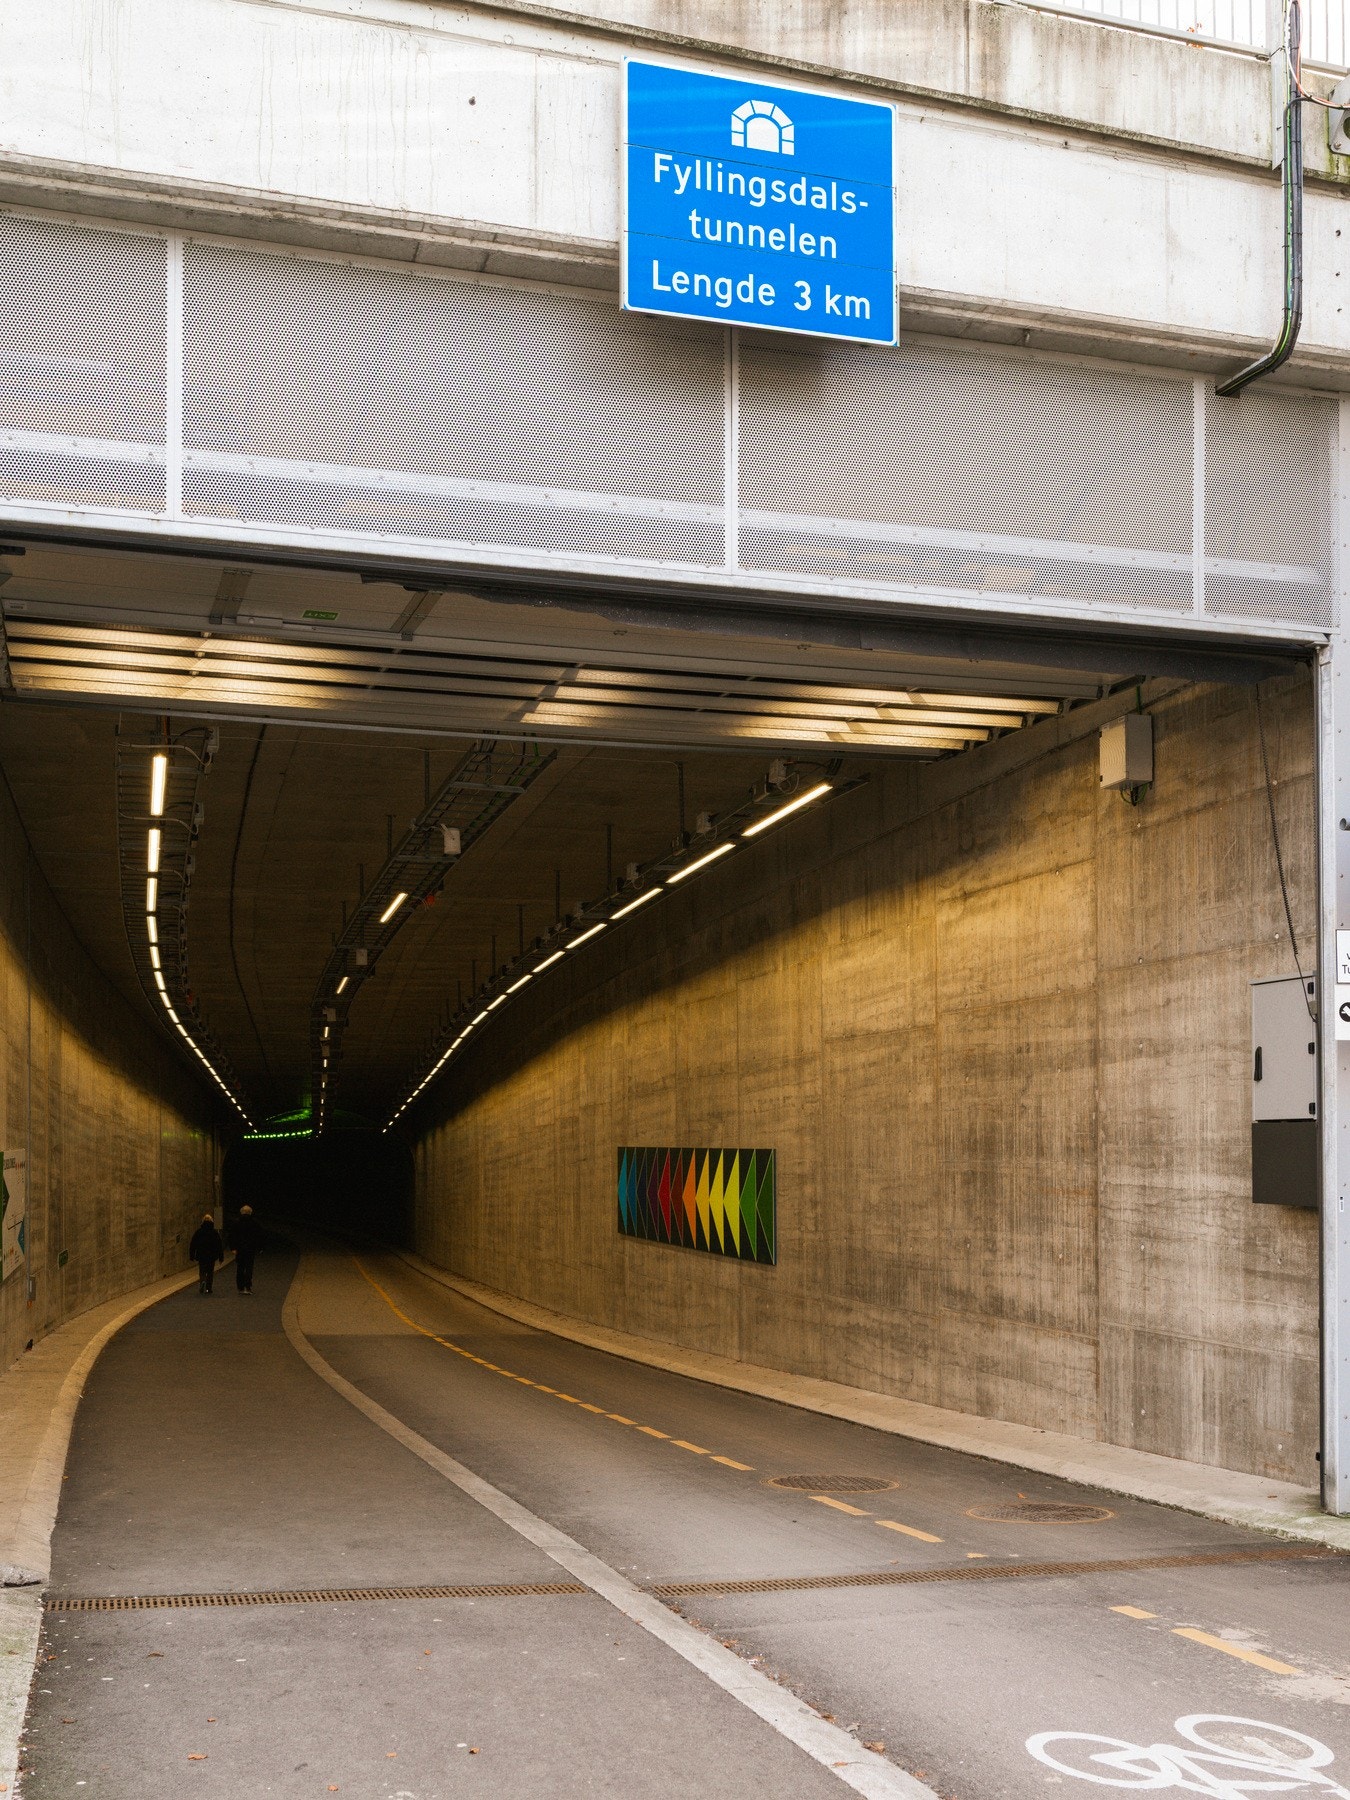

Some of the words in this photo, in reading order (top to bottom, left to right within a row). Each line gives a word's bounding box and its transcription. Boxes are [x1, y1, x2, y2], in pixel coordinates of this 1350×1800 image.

[654, 152, 869, 214] Fyllingsdals-
[689, 208, 837, 259] tunnelen
[652, 260, 776, 308] Lengde
[793, 280, 812, 311] 3
[825, 285, 871, 320] km
